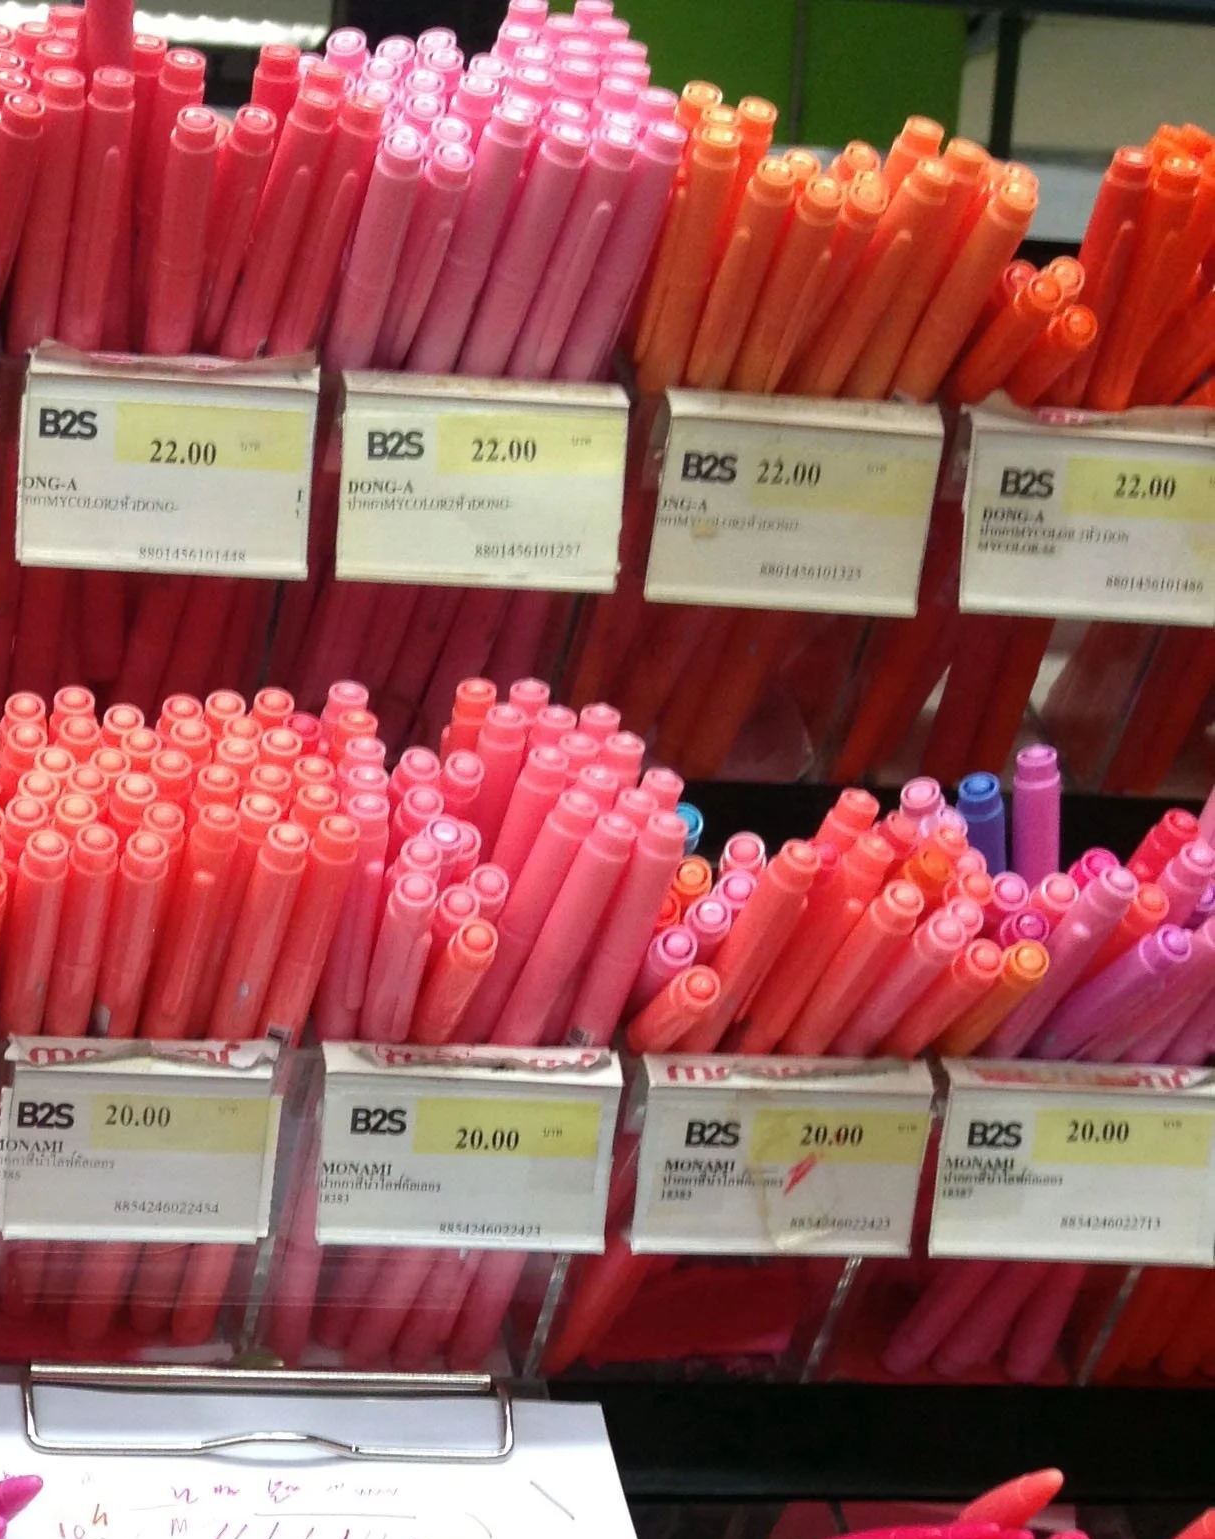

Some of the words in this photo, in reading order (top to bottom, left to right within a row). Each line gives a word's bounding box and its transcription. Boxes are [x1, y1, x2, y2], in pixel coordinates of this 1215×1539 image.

[39, 408, 98, 440] B2S
[150, 440, 217, 465] 22.00
[367, 430, 424, 461] B2S
[472, 438, 537, 463] 22.00
[22, 476, 77, 491] ONG-A
[681, 453, 738, 484] B2S
[757, 459, 821, 487] 22.00
[1000, 466, 1054, 499] B2S
[1114, 473, 1176, 500] 22.00
[348, 480, 413, 494] DONG-A
[17, 1102, 74, 1129] B2S
[105, 1105, 171, 1127] 20.00
[351, 1108, 406, 1136] B2S
[456, 1127, 519, 1150] 20.00
[685, 1121, 740, 1147] B2S
[800, 1124, 863, 1147] 20.00
[967, 1121, 1022, 1149] B2S
[1067, 1120, 1129, 1144] 20.00
[321, 1162, 392, 1177] MONAMI
[664, 1159, 735, 1174] MONAMI
[945, 1157, 1014, 1171] MONAMI
